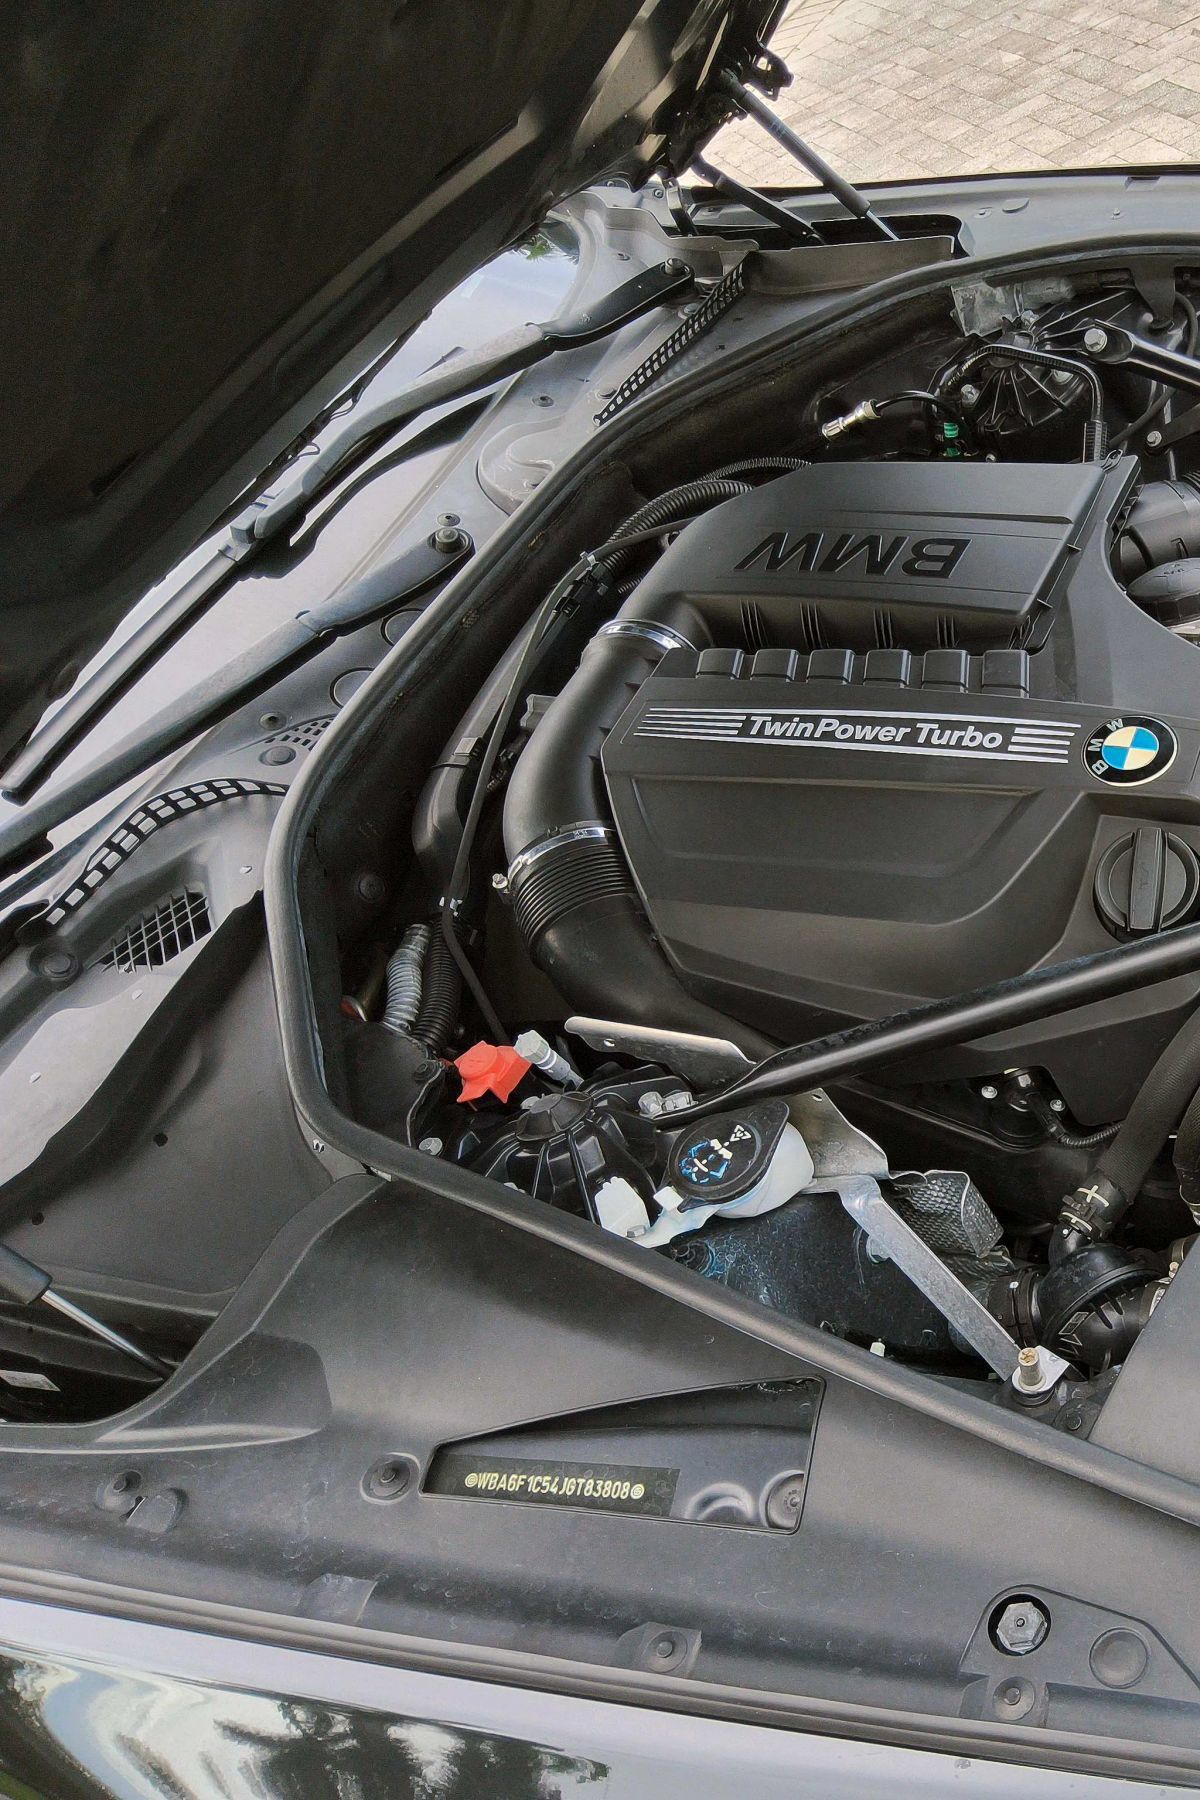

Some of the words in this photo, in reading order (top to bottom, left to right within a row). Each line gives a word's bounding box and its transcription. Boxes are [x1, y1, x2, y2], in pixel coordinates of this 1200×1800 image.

[733, 533, 972, 579] BMW
[917, 723, 1003, 750] Turbo
[1089, 718, 1125, 775] BMW
